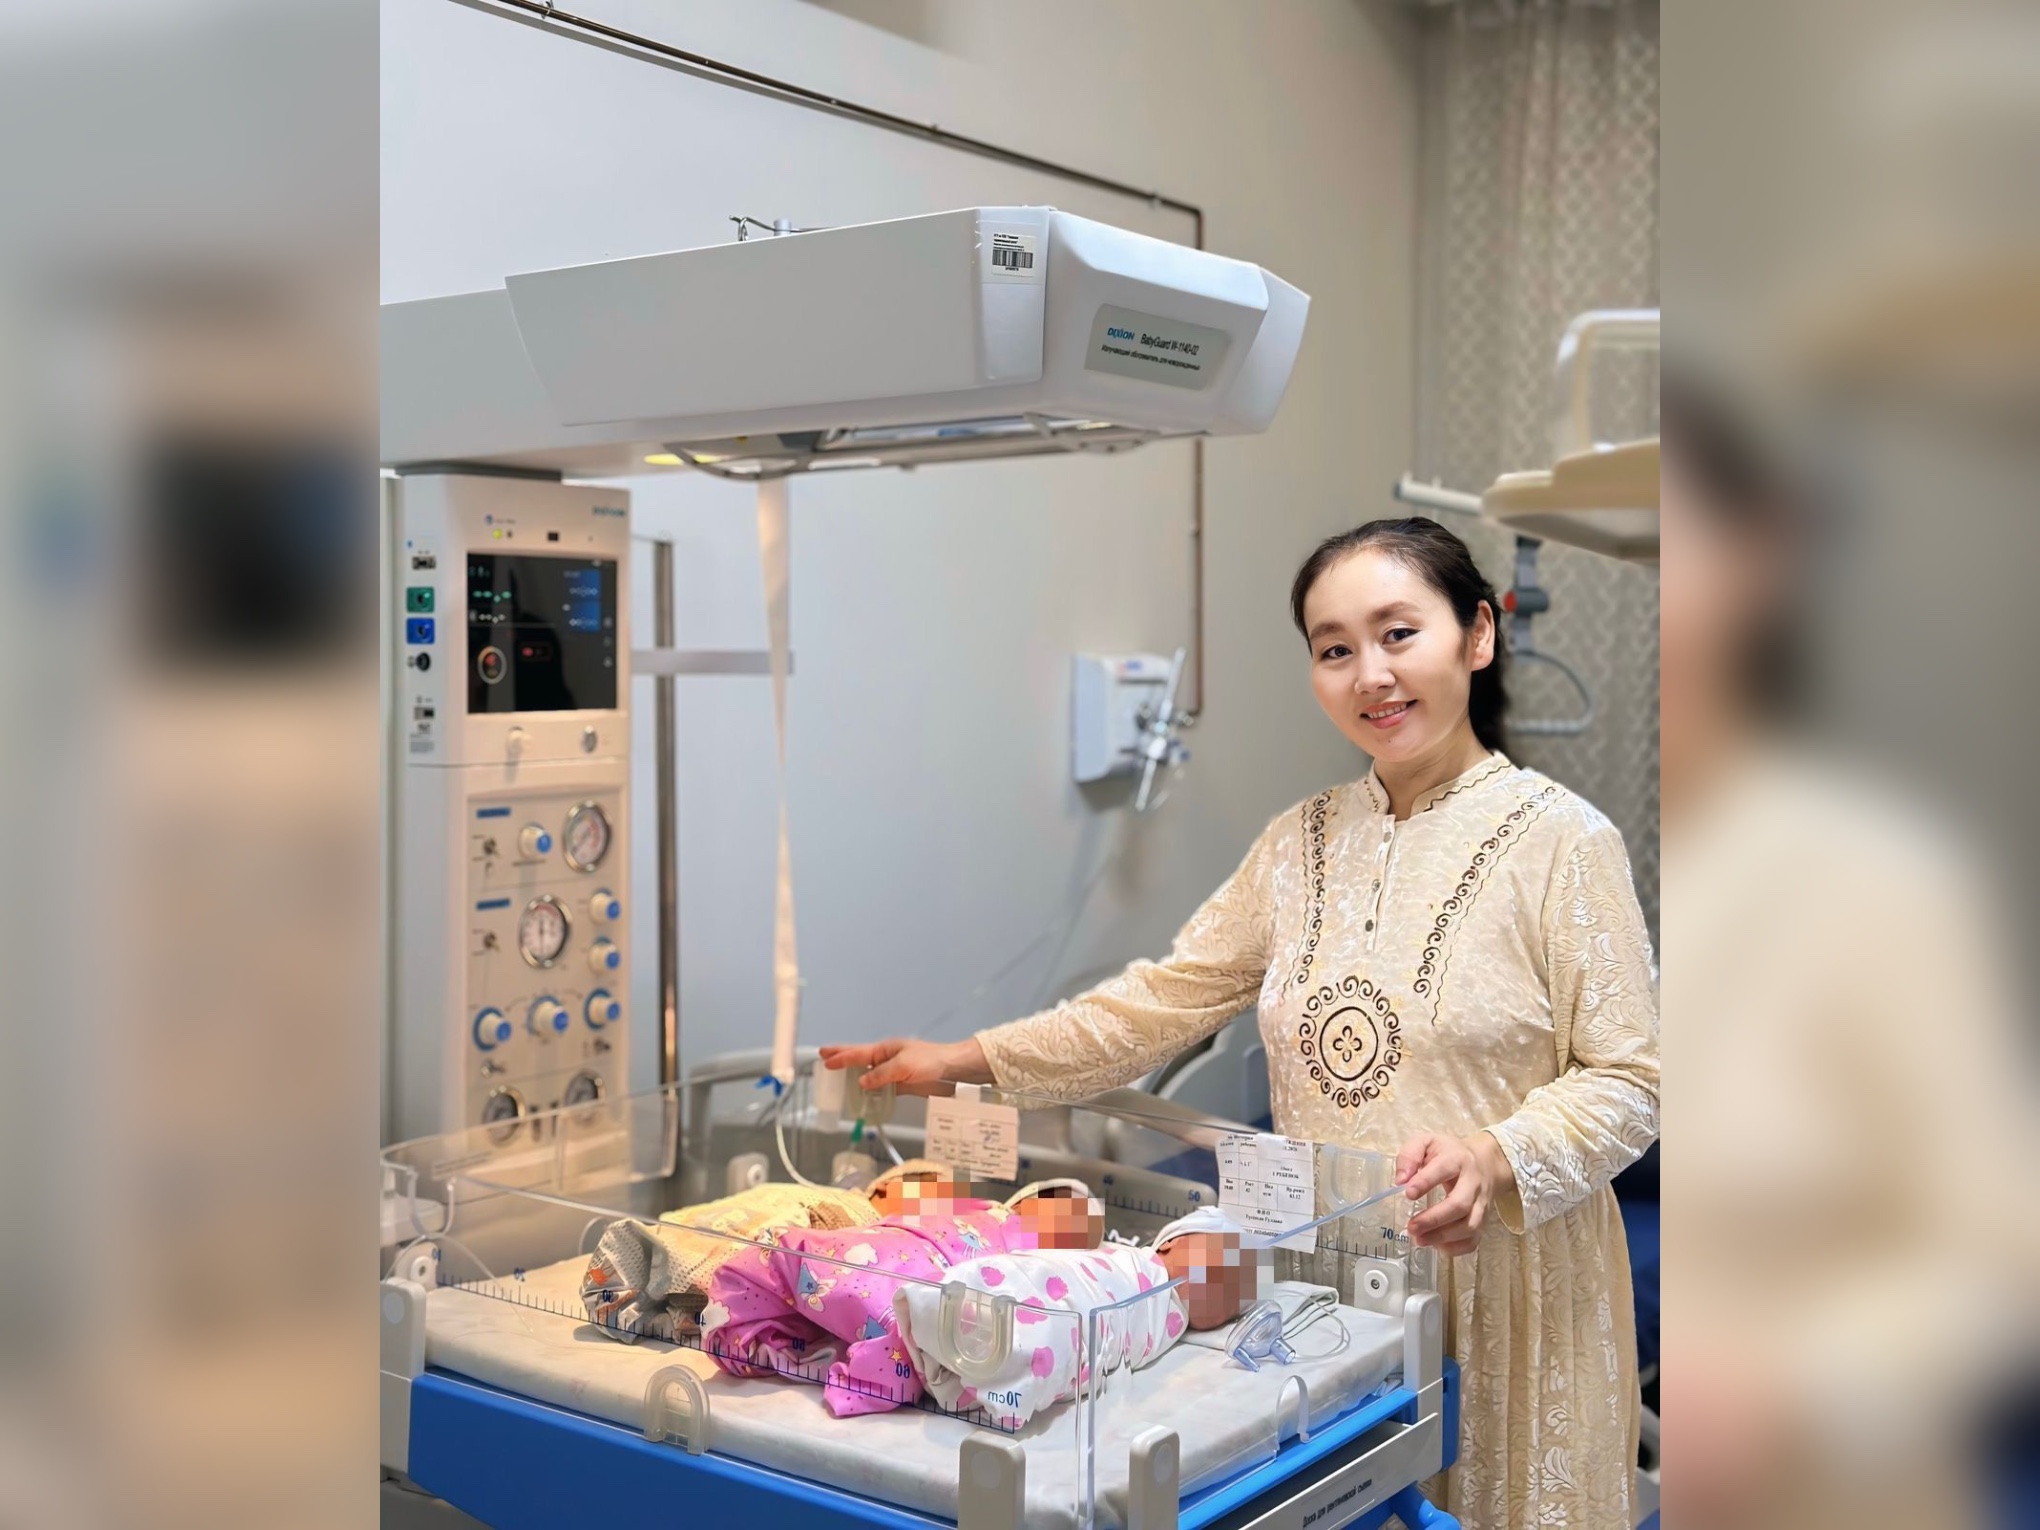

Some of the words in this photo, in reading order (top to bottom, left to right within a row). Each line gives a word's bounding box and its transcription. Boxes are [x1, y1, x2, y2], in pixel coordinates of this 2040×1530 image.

[1107, 327, 1135, 341] DIXION
[1140, 333, 1171, 349] BabyGuard
[1188, 1189, 1201, 1202] 50
